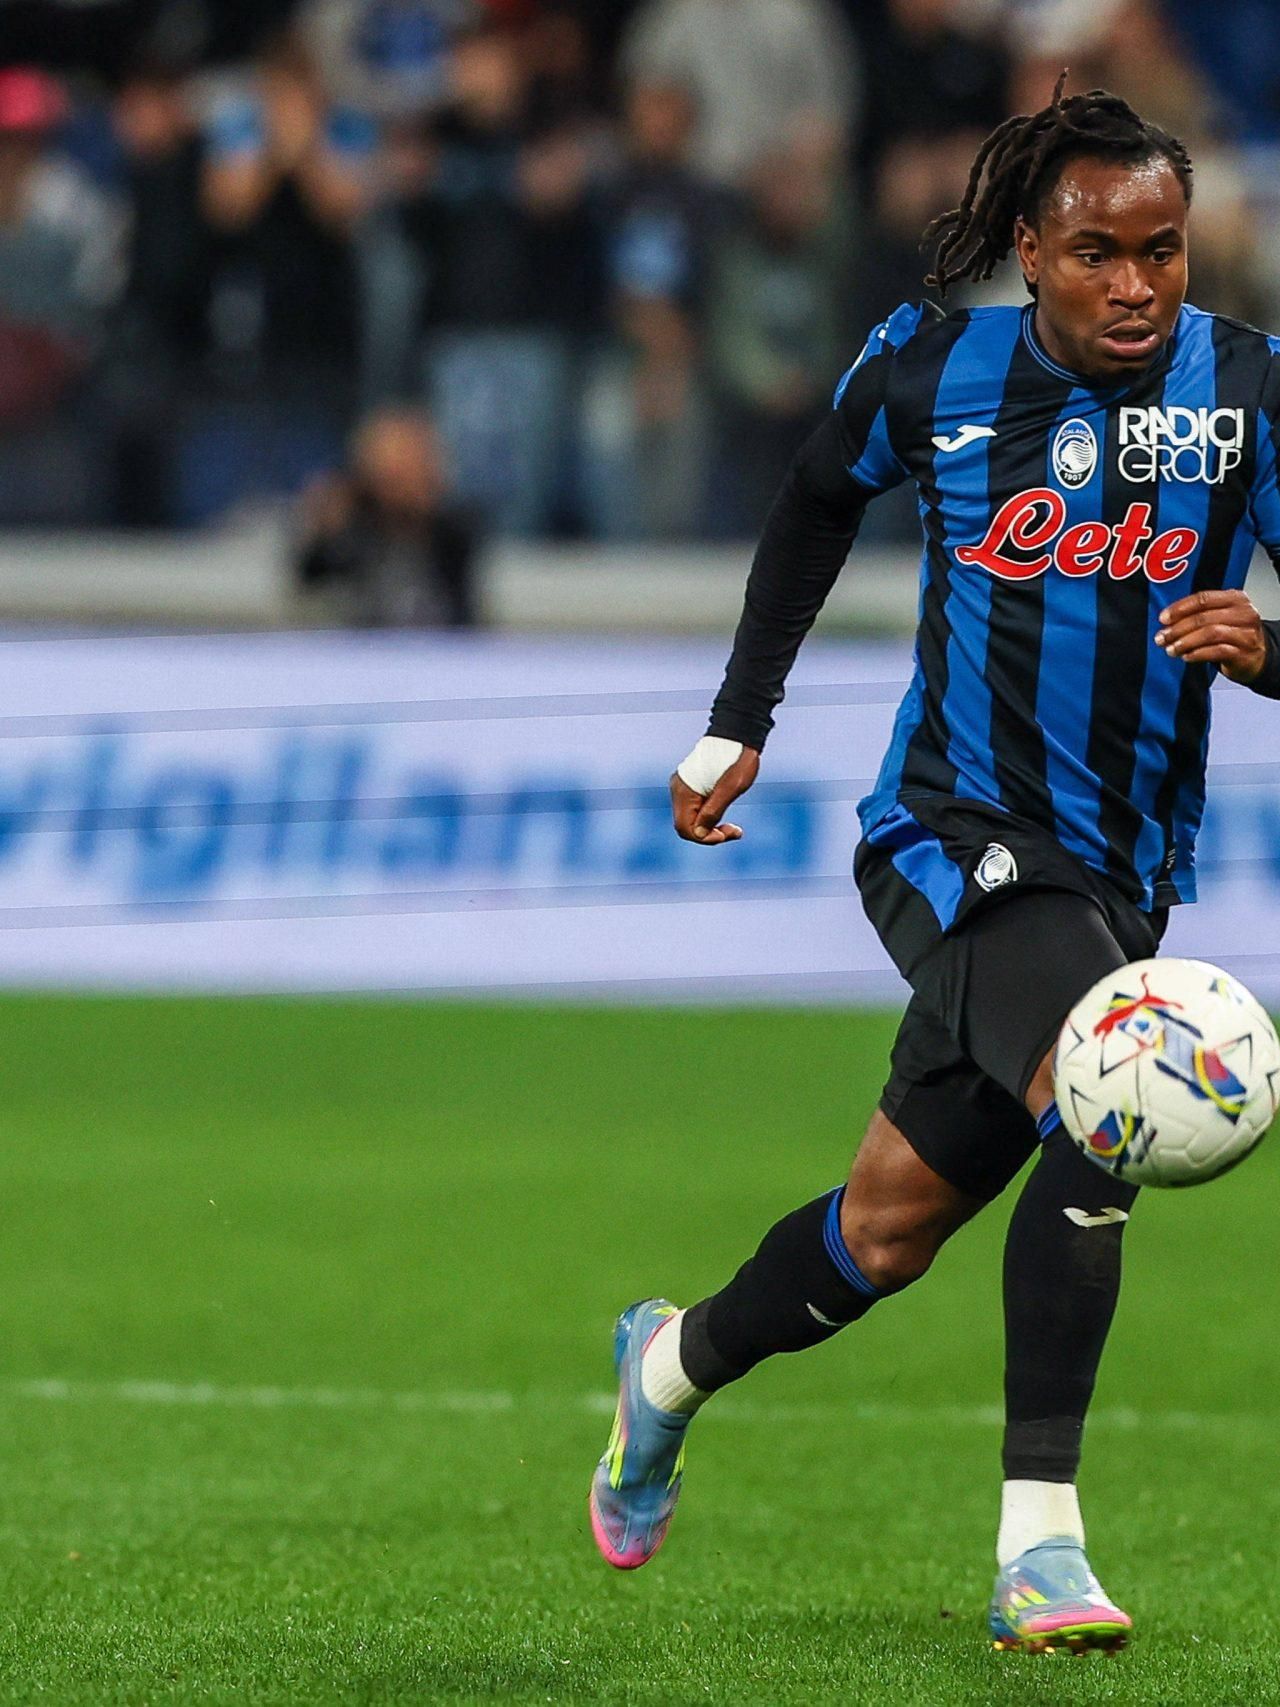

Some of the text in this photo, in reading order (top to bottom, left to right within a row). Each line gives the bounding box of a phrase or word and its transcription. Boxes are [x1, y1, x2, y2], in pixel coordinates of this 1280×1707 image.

[1118, 406, 1244, 448] RADICI
[1118, 443, 1241, 484] GROUP
[955, 487, 1199, 583] Lete
